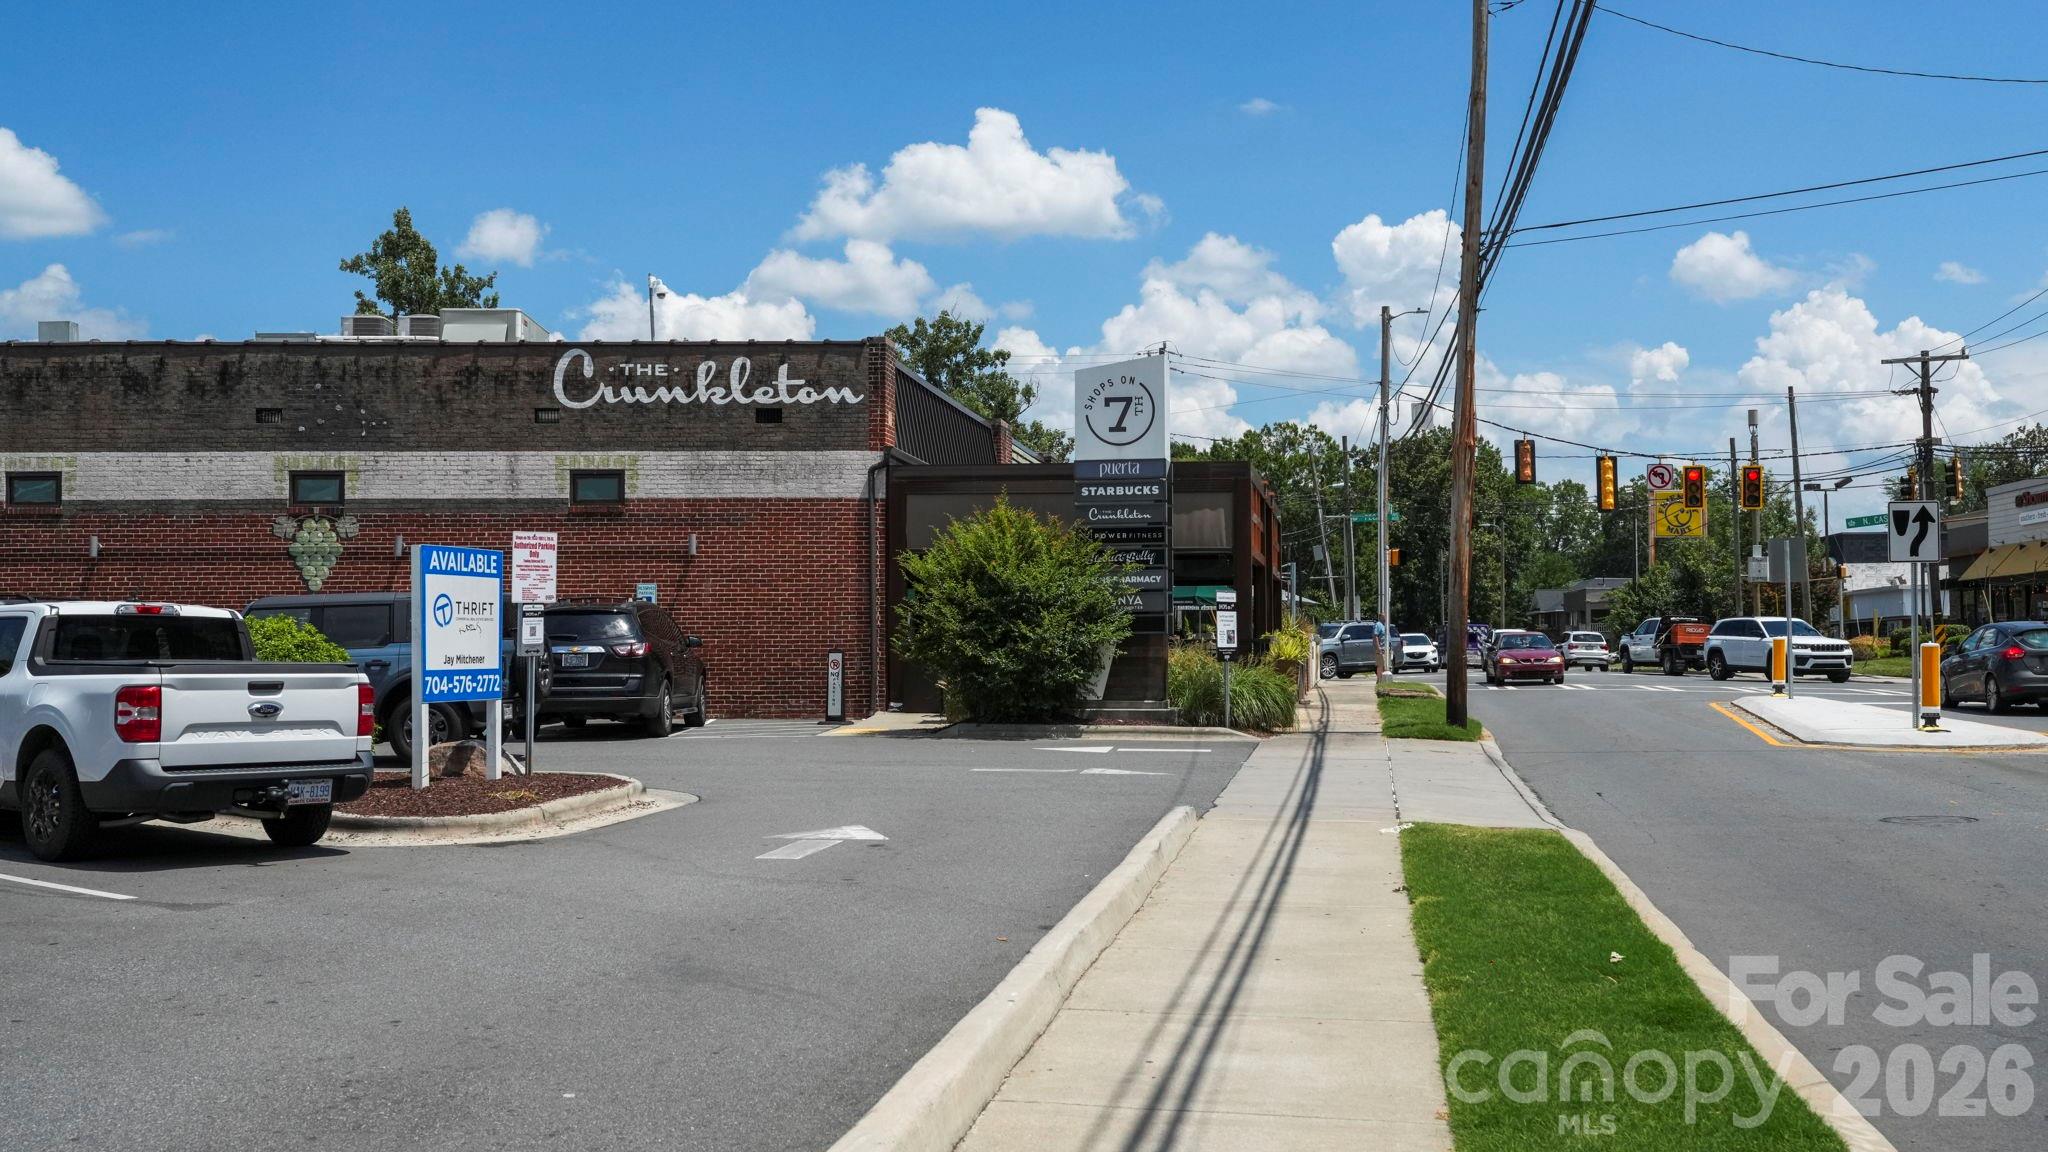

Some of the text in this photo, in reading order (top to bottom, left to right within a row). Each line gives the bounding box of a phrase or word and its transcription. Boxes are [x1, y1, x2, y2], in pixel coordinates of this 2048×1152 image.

[620, 363, 668, 376] THE
[553, 348, 864, 409] Crunkleton
[1084, 375, 1136, 411] SHOPS ON
[1104, 396, 1144, 432] 7 TH
[1099, 461, 1140, 478] puerta
[1081, 485, 1160, 496] STARBUCKS
[1088, 507, 1152, 521] Crunkleton
[538, 542, 556, 551] Parking
[429, 550, 498, 574] AVAILABLE
[455, 601, 495, 616] THRIFT
[443, 654, 485, 667] Jay Mitchener
[424, 674, 500, 695] 704-576-2772
